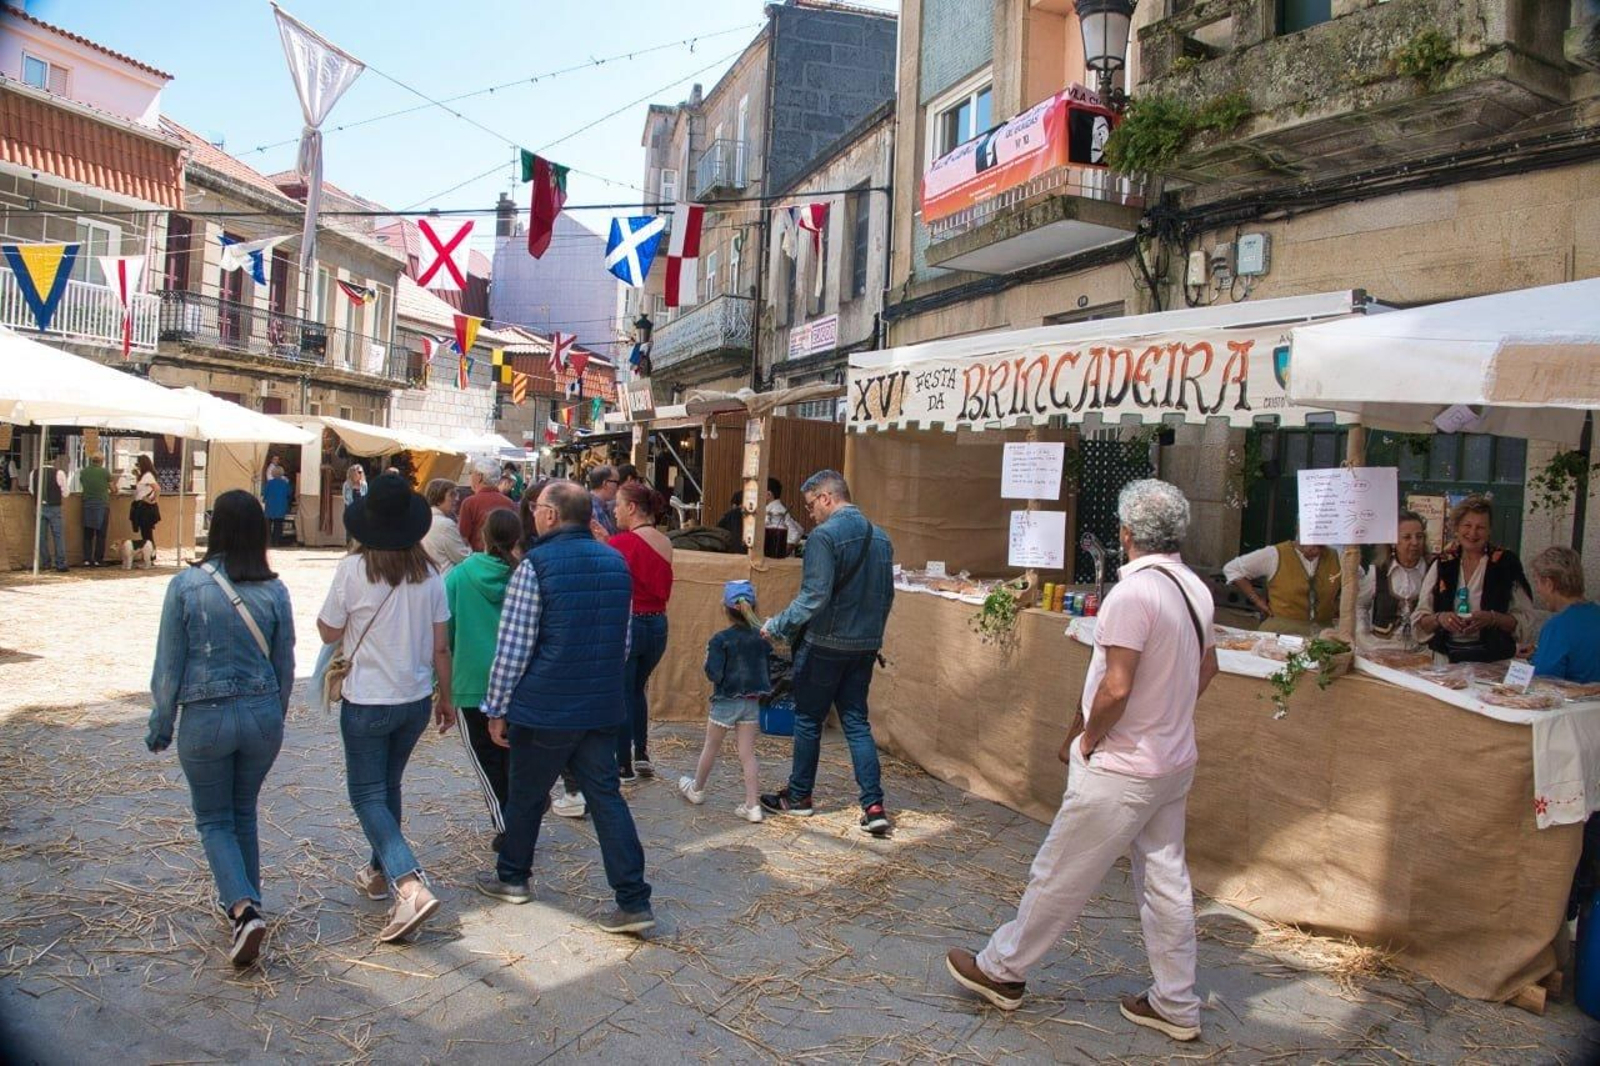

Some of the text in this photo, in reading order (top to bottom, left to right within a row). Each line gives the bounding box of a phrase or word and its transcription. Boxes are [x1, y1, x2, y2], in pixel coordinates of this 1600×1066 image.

[851, 367, 957, 421] XVI FESTA
[926, 392, 945, 412] DA
[957, 340, 1255, 421] BRINCADEIRA
